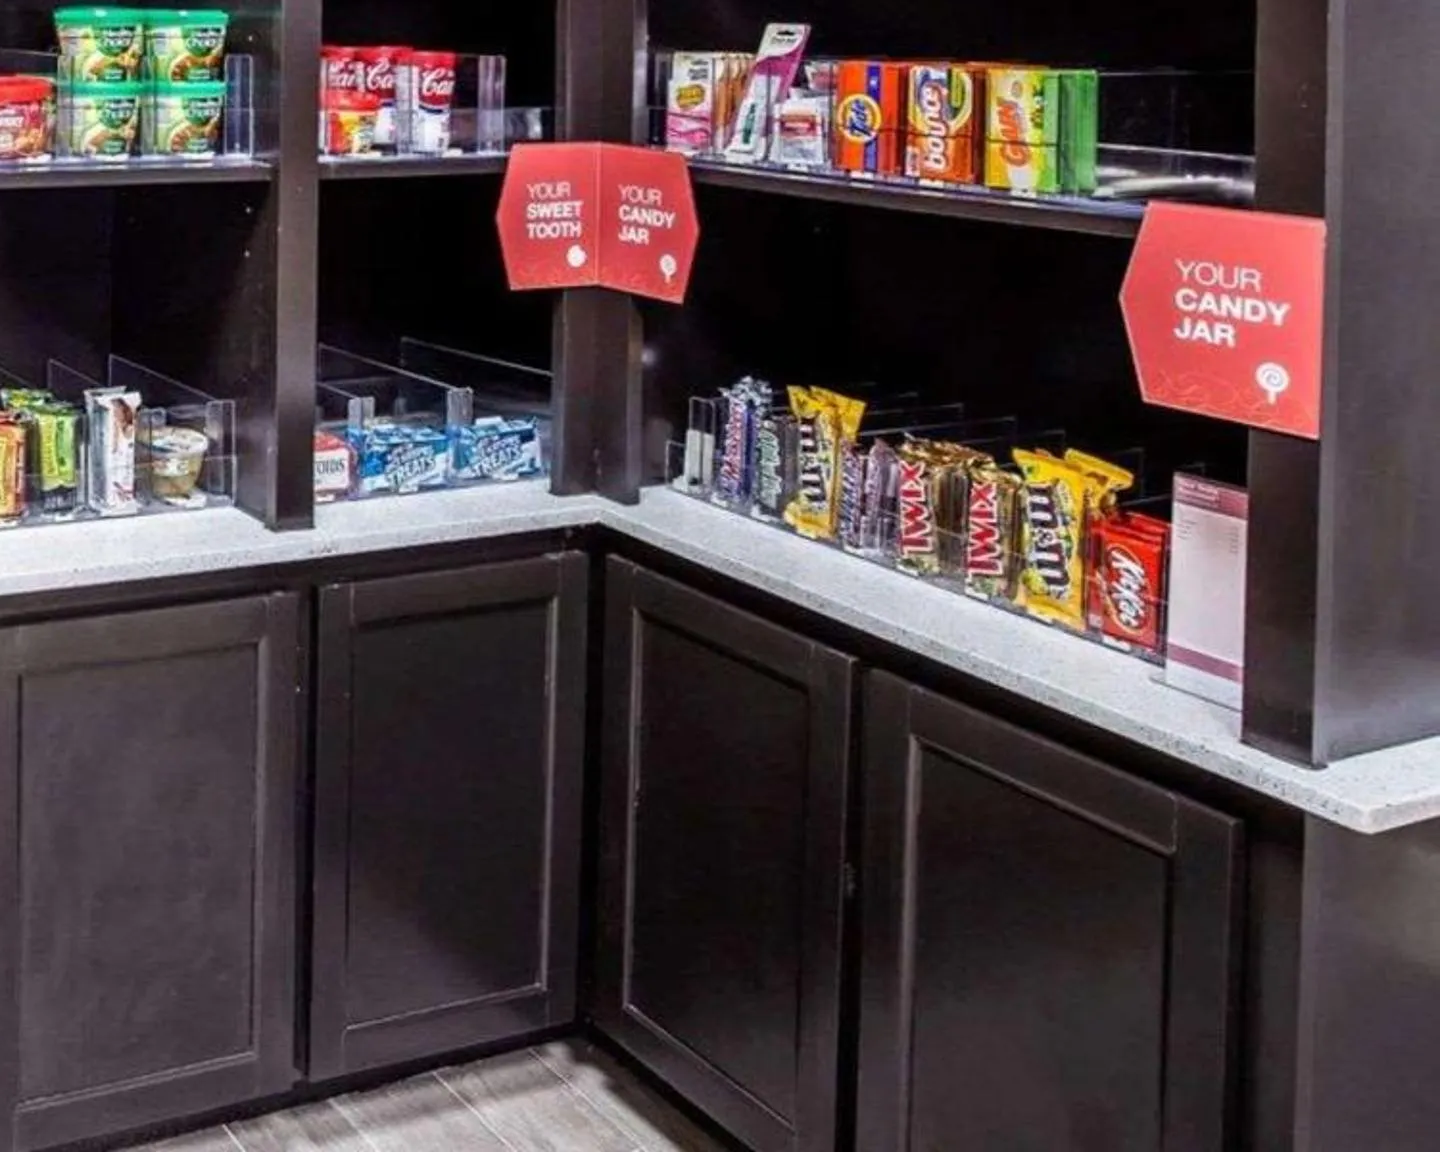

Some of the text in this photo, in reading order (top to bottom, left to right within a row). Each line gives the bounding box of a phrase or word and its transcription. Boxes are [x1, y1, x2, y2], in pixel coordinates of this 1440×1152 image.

[845, 99, 871, 138] Tide
[527, 181, 571, 200] YOUR
[618, 184, 663, 206] YOUR
[526, 201, 584, 220] SWEET
[618, 204, 676, 229] CANDY
[526, 221, 582, 239] TOOTH
[618, 225, 650, 247] JAR
[1174, 258, 1262, 293] YOUR
[1174, 288, 1291, 326] CANDY
[1174, 316, 1236, 348] JAR
